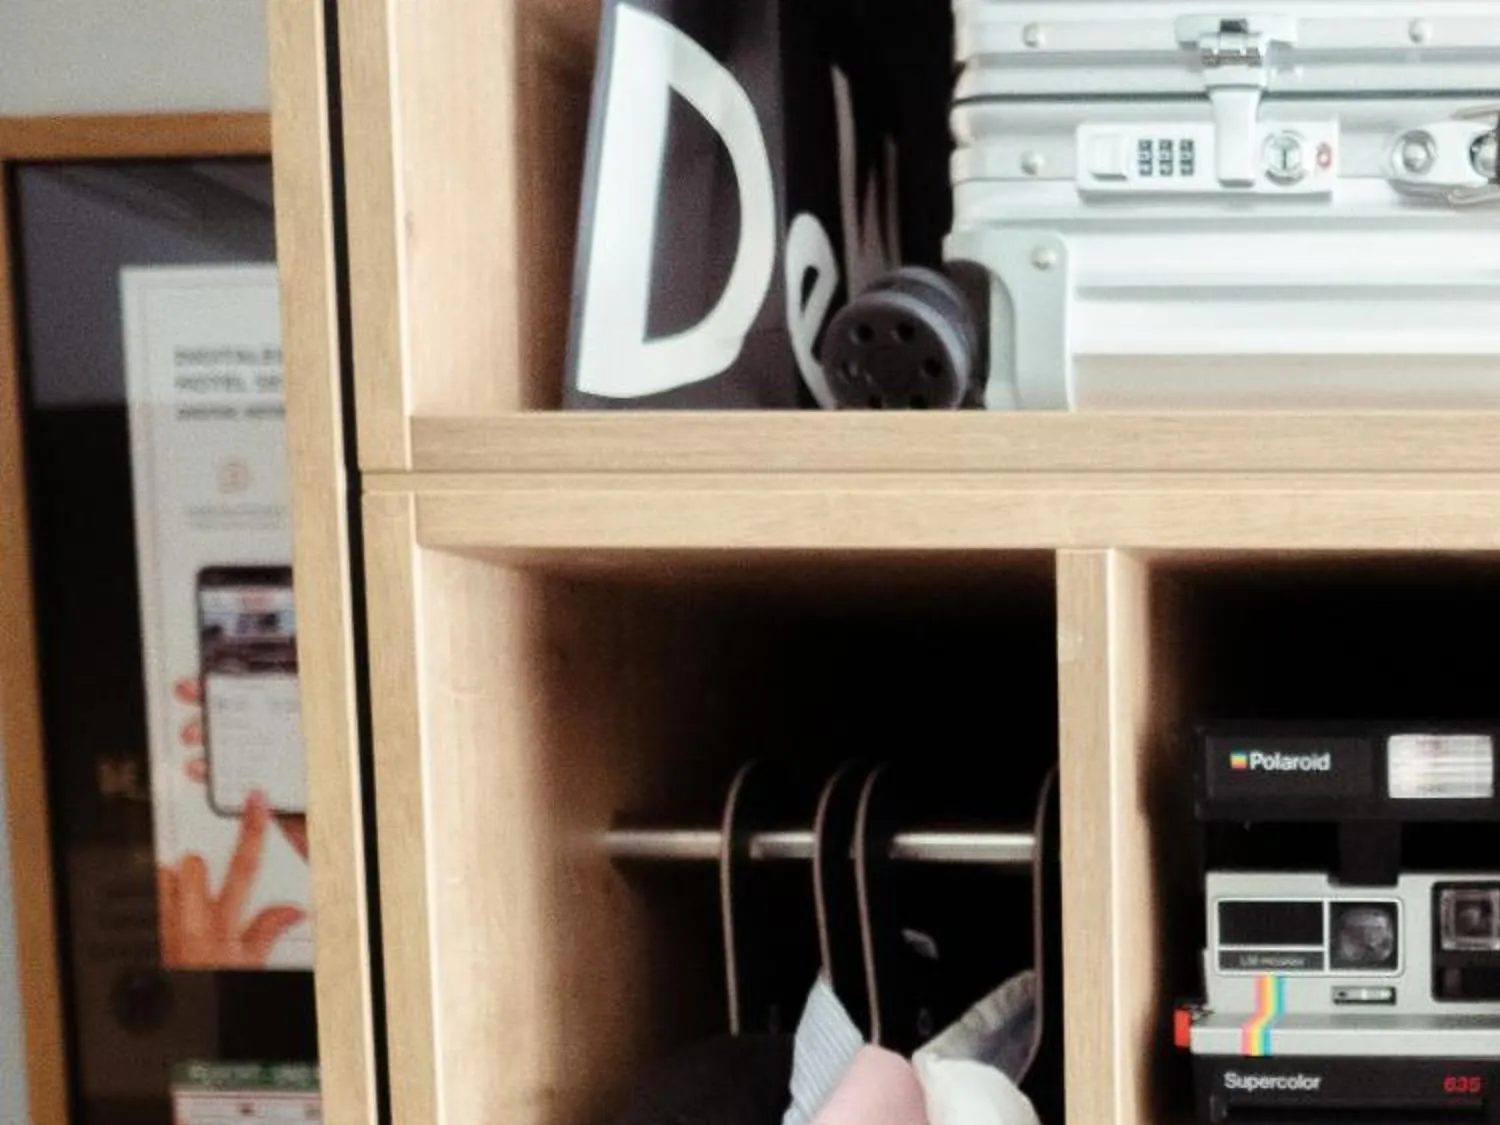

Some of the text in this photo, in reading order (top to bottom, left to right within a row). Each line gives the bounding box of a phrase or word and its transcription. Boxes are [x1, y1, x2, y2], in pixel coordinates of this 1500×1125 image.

[1249, 750, 1331, 771] Polaroid
[1224, 1071, 1322, 1092] Supercolor
[1443, 1075, 1482, 1093] 635
